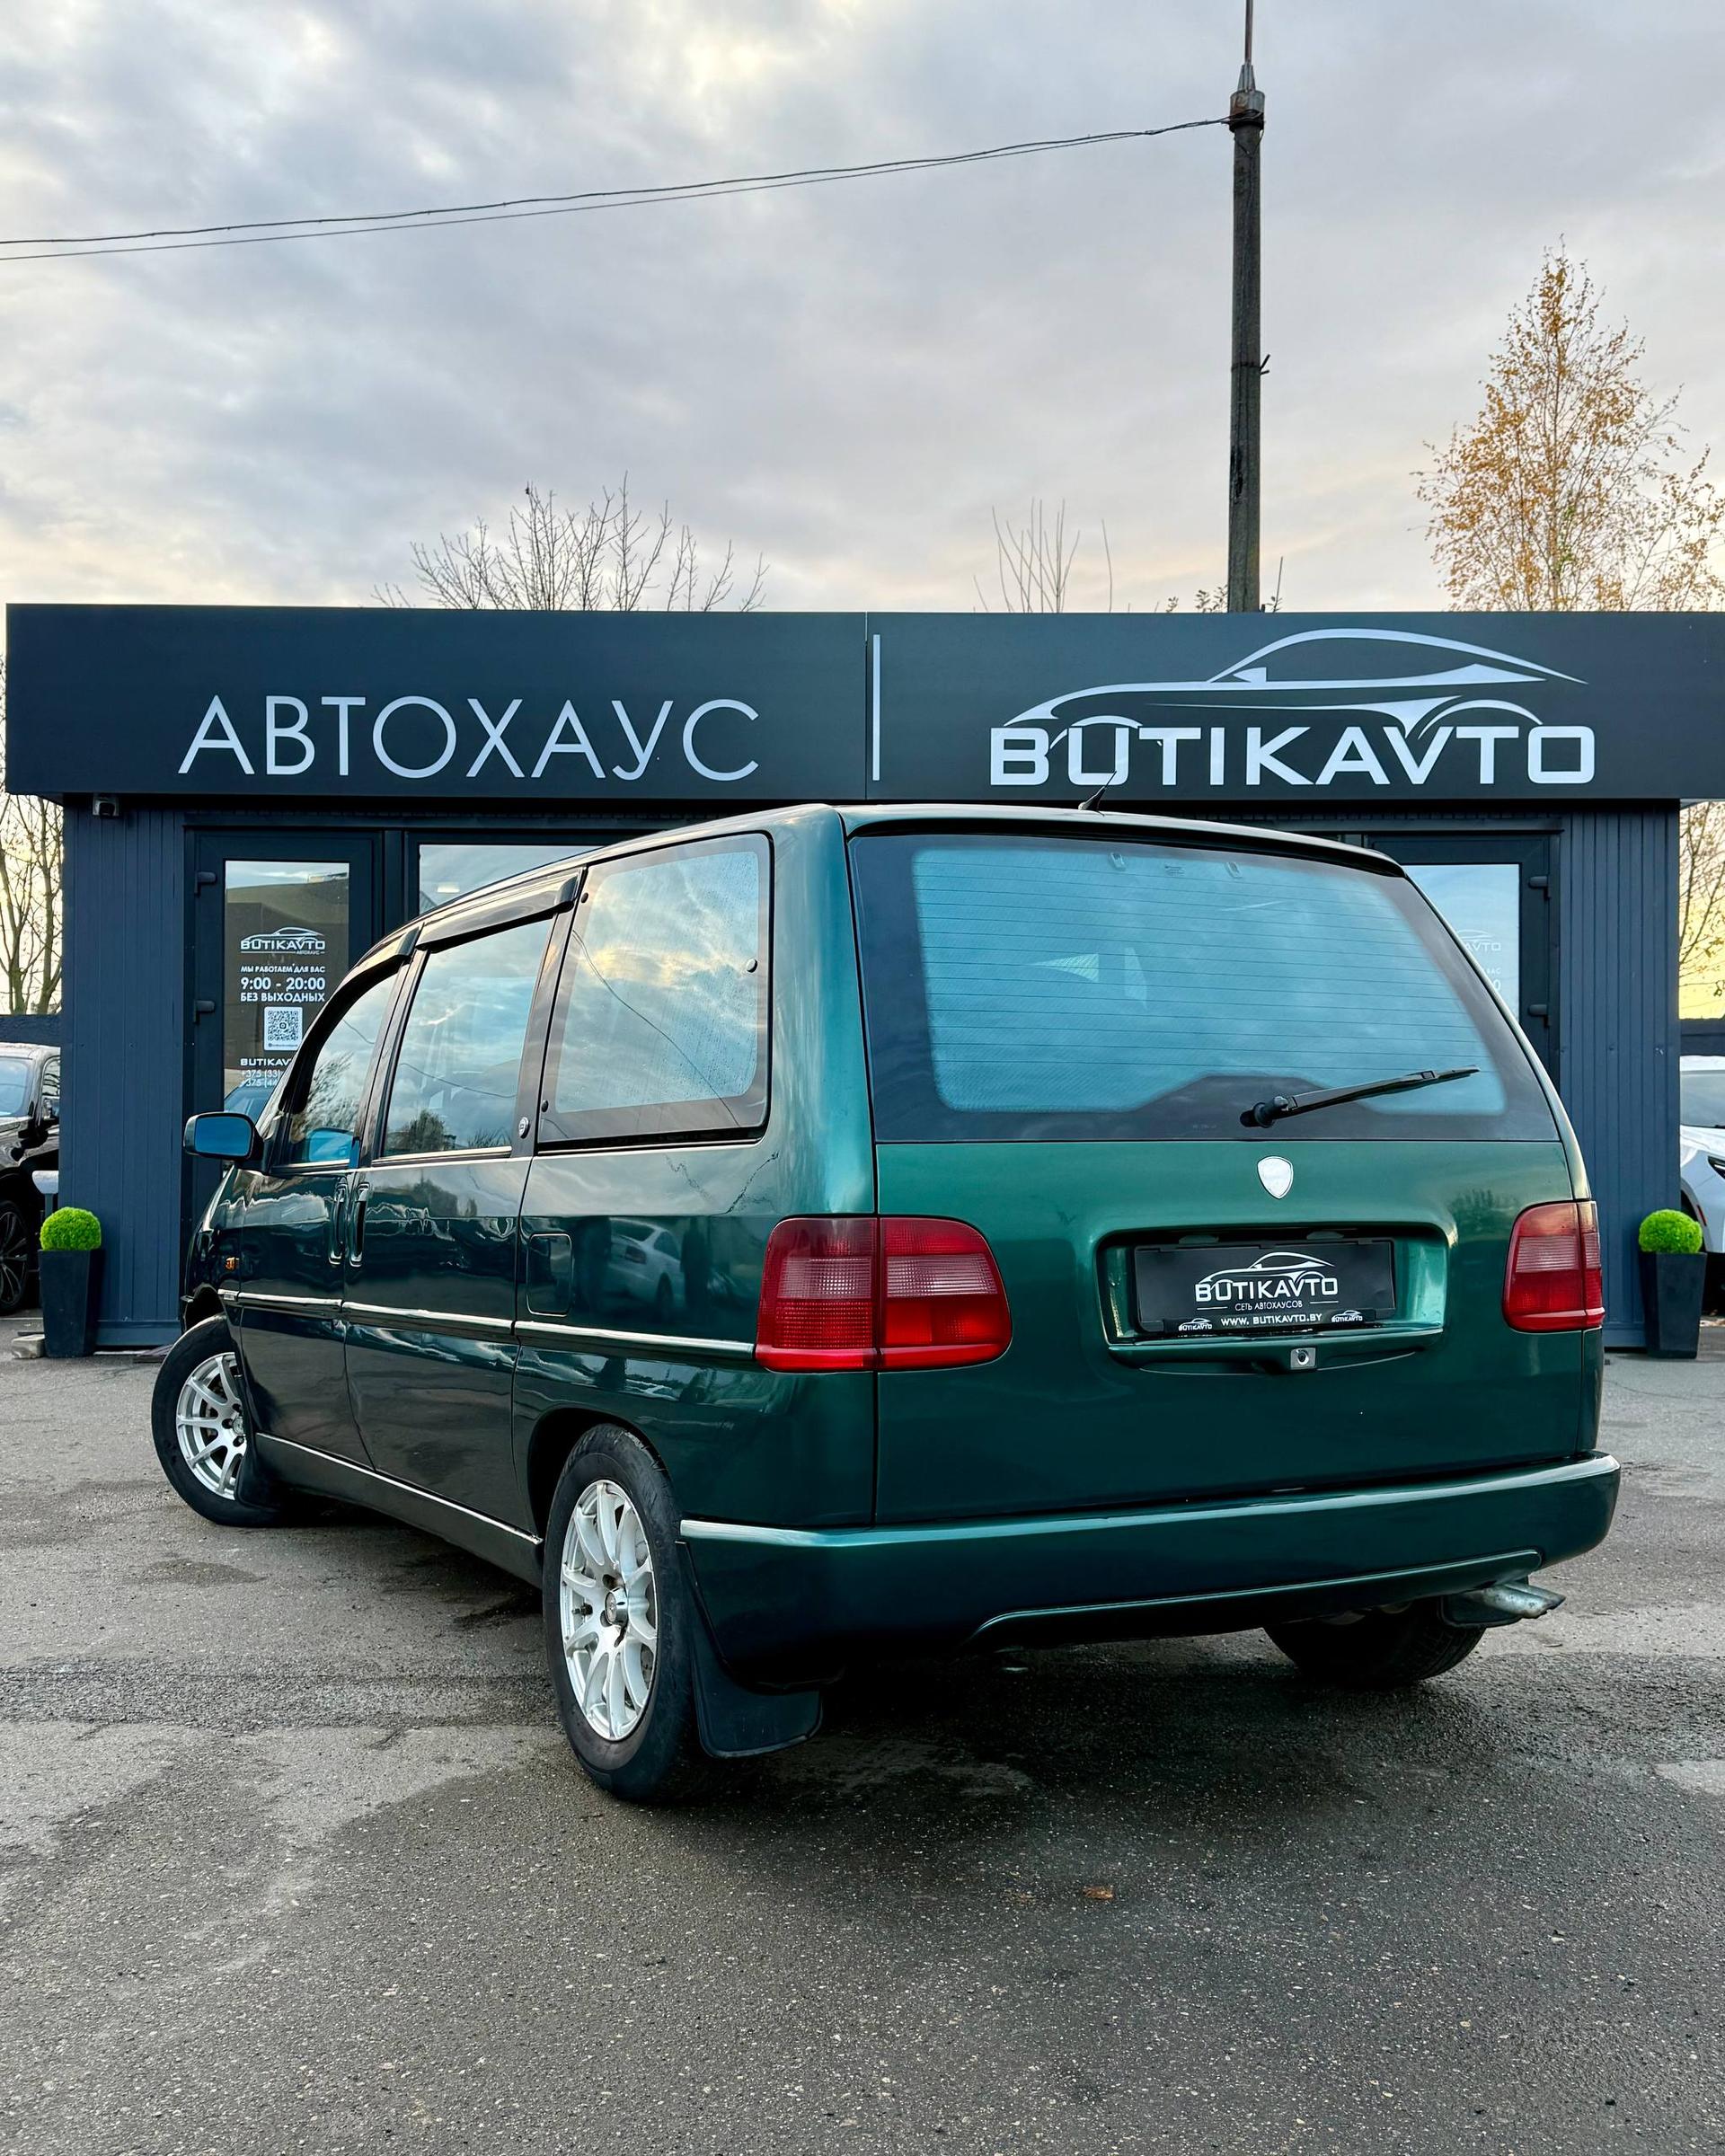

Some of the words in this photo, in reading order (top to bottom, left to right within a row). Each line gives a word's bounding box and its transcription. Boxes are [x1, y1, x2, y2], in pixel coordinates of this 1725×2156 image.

[178, 694, 760, 782] АВТОХАУС
[990, 726, 1596, 787] BUTIKAVTO
[240, 941, 325, 950] BUTIKAVTO
[240, 965, 254, 973] МЫ
[254, 965, 293, 973] РАБОТАЕМ
[293, 965, 309, 974] ДЛЯ
[310, 965, 326, 973] ВАС
[240, 976, 272, 990] 9:00
[286, 976, 326, 991] 20:00
[240, 992, 259, 1002] БЕЗ
[261, 992, 326, 1003] ВЫХОДНЫХ
[240, 1057, 292, 1066] BUTIKAV
[1195, 1277, 1339, 1303] BUTIKAVTO
[1234, 1303, 1253, 1312] СЕТЬ
[1254, 1300, 1304, 1311] АВТОХАУСОВ
[1252, 1313, 1322, 1325] BUTIKAVTO.BY
